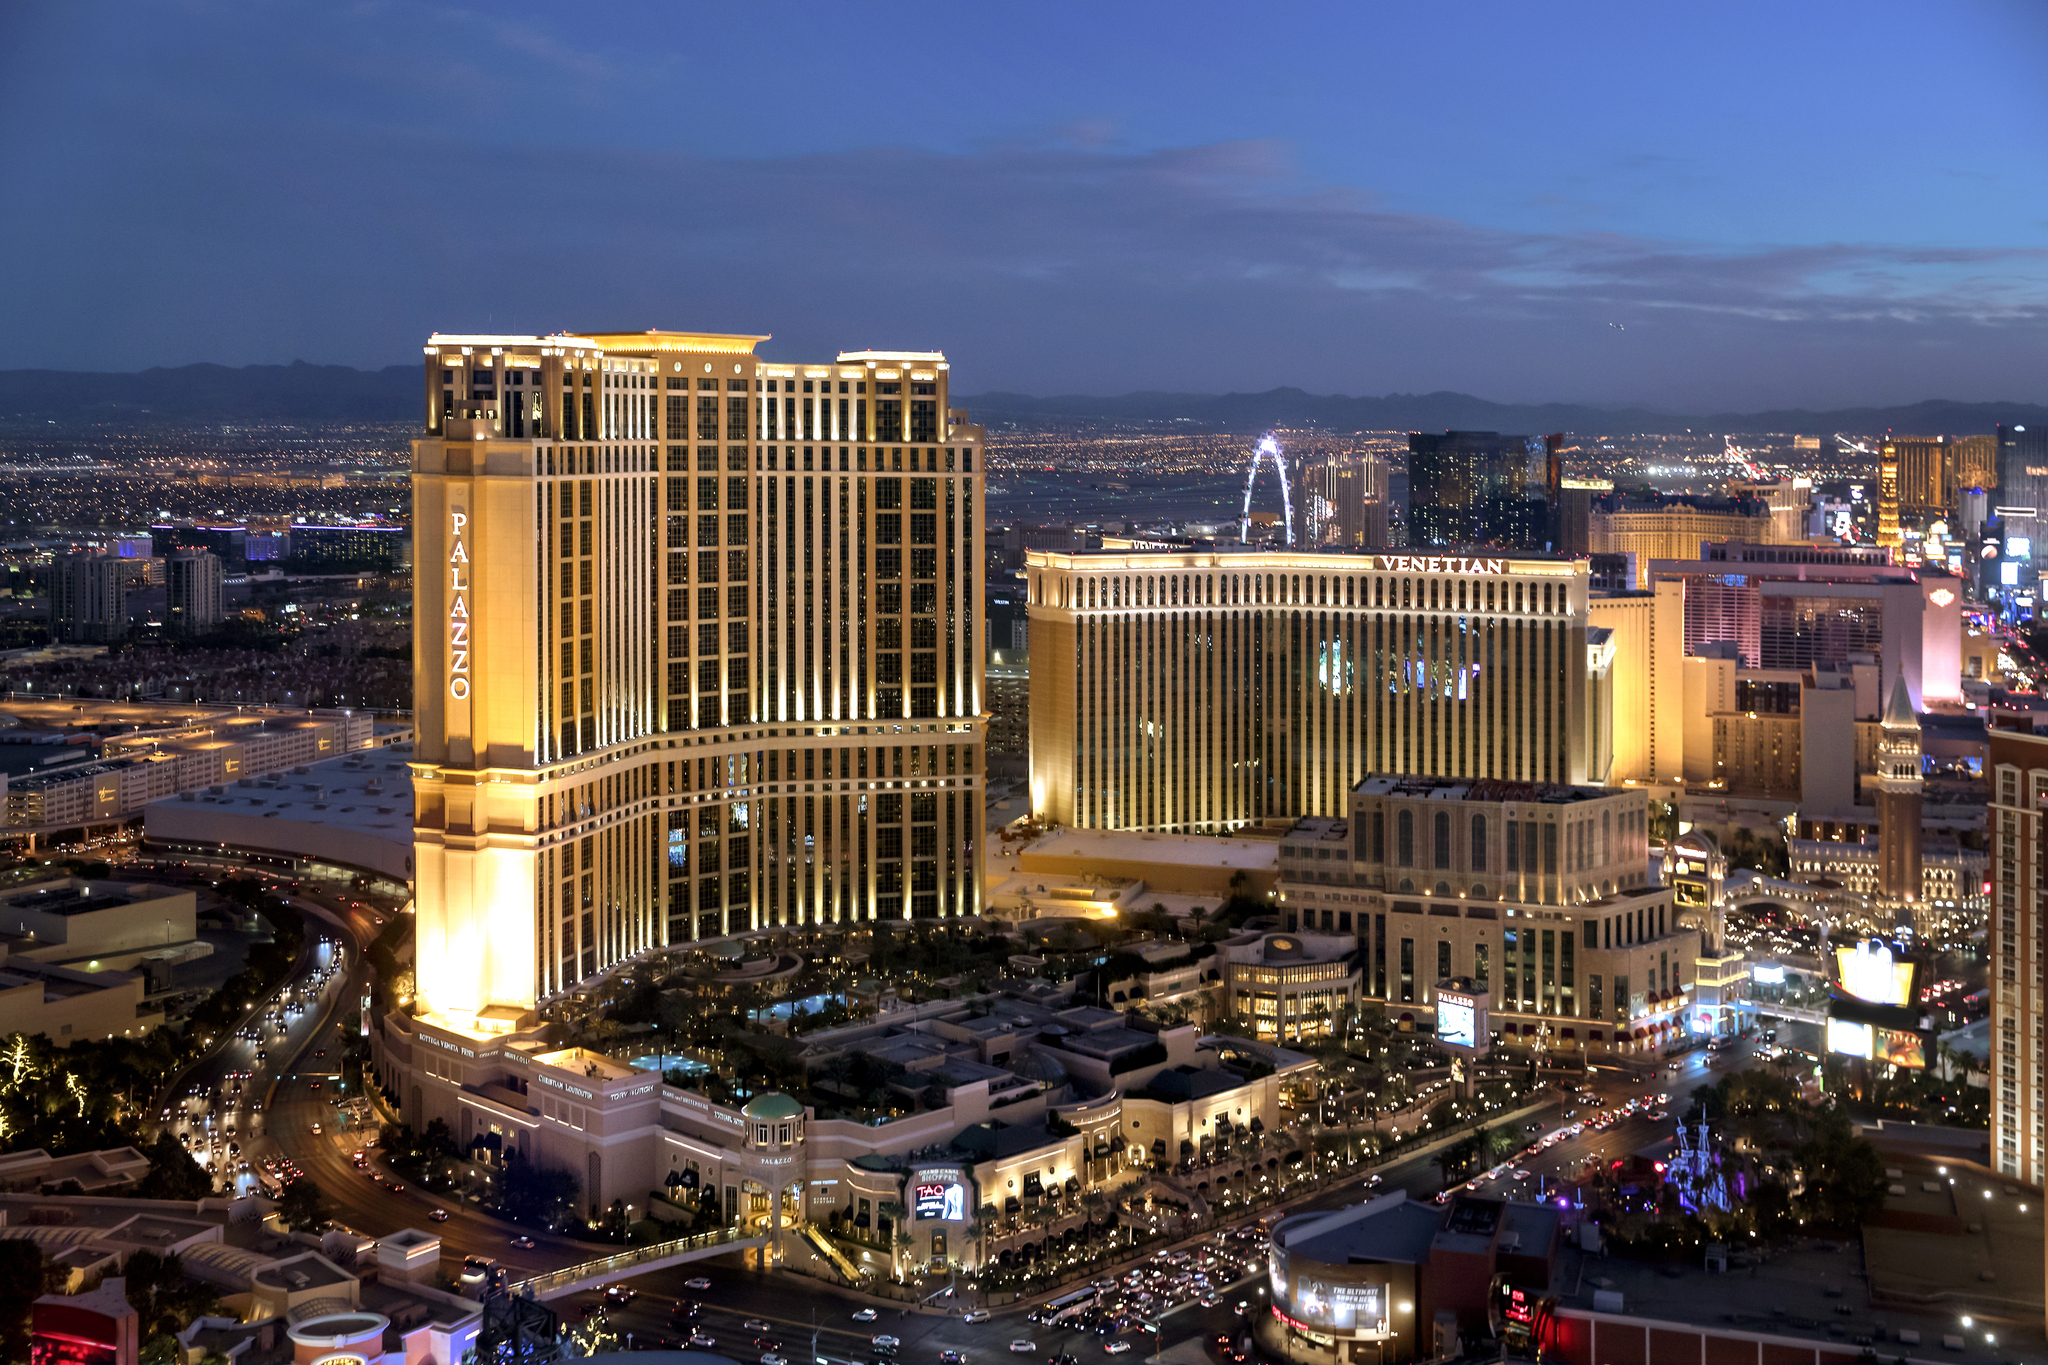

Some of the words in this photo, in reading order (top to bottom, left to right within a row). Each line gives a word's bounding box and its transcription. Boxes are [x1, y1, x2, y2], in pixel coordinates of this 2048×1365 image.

[1379, 554, 1504, 575] VENETIAN
[450, 513, 470, 700] PALAZZO
[1438, 992, 1474, 1008] PALAZZO
[419, 1032, 440, 1047] BOTTEGA
[538, 1073, 564, 1090] CHRISTIAN
[565, 1083, 594, 1100] LOUBOUTIN
[610, 1090, 629, 1101] TORY
[761, 1157, 792, 1165] PALAZZO
[916, 1184, 945, 1198] TAO
[1333, 1286, 1346, 1294] THE
[1346, 1287, 1378, 1296] ULTIMATE
[1272, 1304, 1281, 1319] CVS
